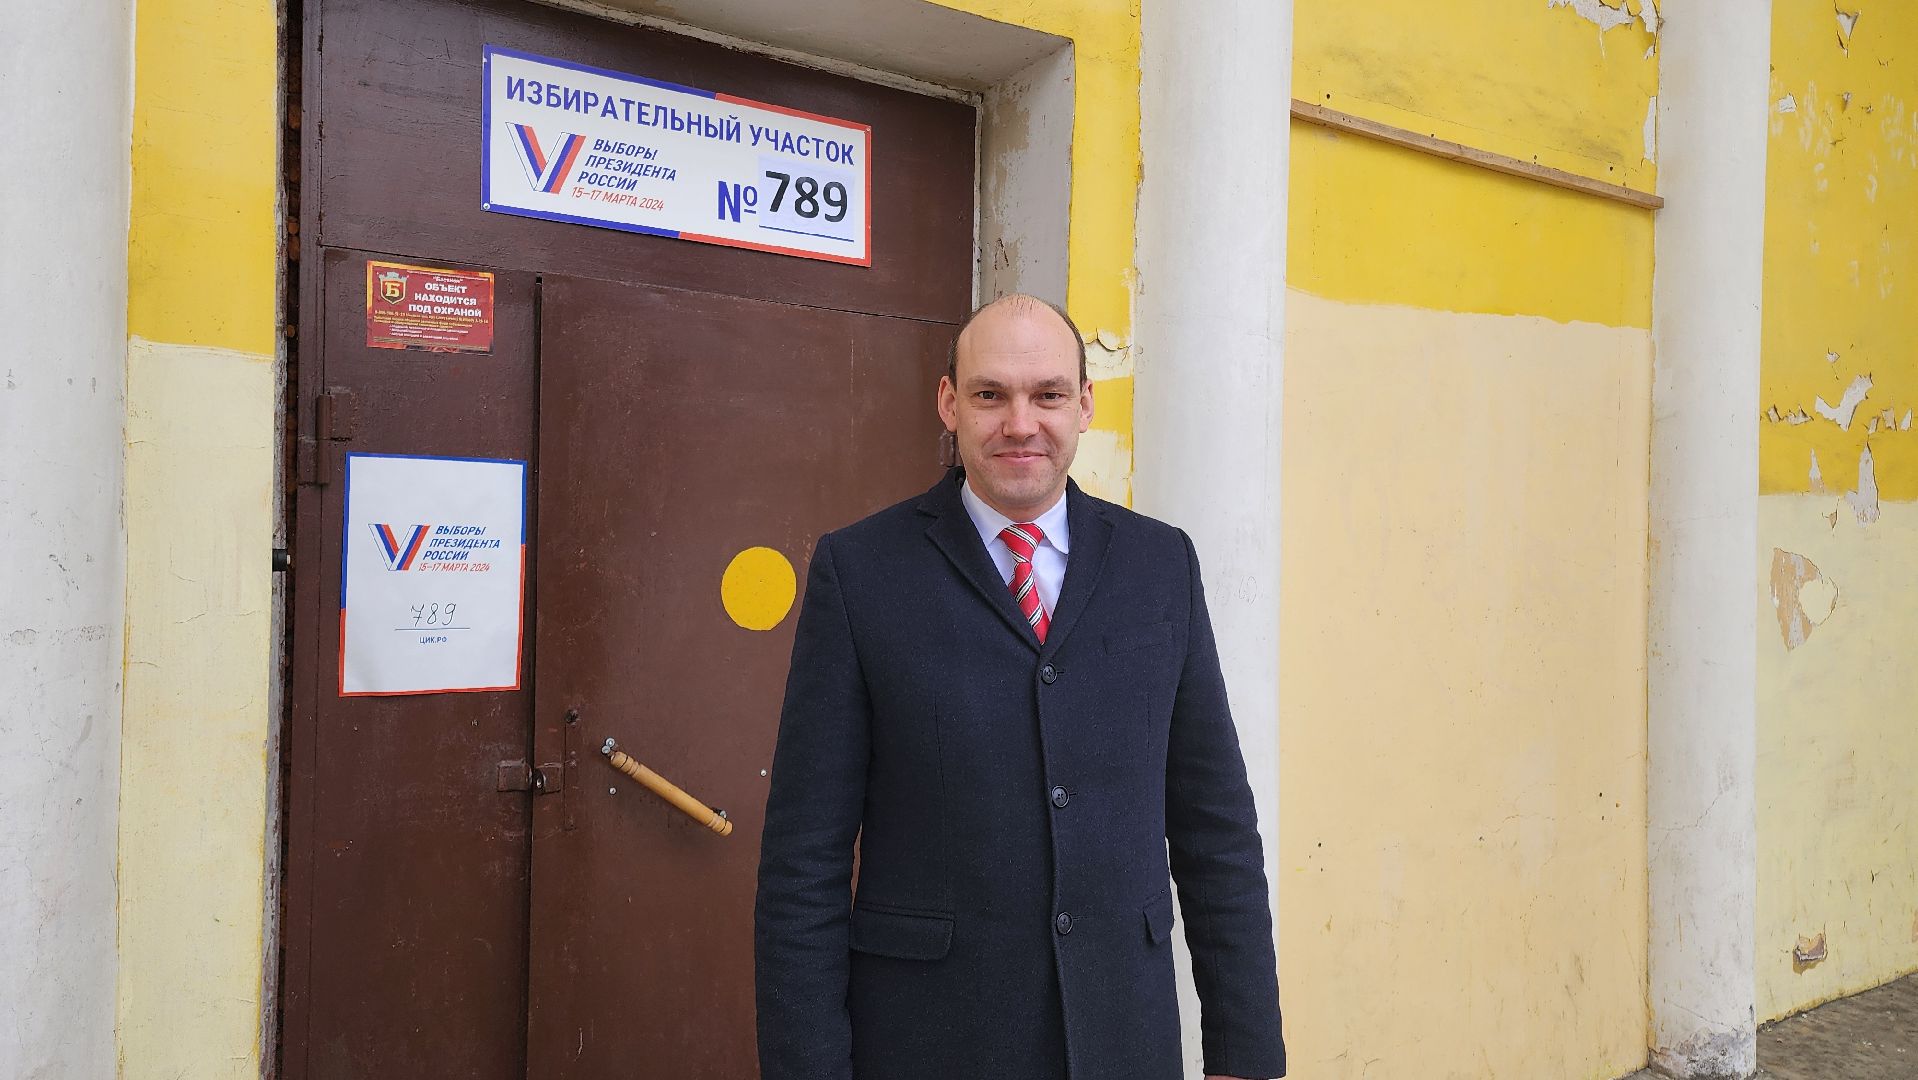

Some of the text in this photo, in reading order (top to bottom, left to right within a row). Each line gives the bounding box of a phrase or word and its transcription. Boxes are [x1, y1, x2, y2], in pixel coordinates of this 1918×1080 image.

[506, 75, 855, 166] ИЗБИРАТЕЛЬНЫЙ УЧАСТОК
[593, 138, 658, 161] ВЫБОРЫ
[585, 154, 677, 182] ПРЕЗИДЕНТА
[577, 170, 639, 192] РОССИИ
[602, 191, 638, 207] МАРТА
[639, 197, 665, 212] 2024
[718, 170, 848, 223] № 789
[424, 282, 468, 294] ОБЪЕКТ
[414, 292, 477, 306] НАХОДИТСЯ
[408, 303, 432, 315] ПОД
[433, 305, 482, 318] ОХРАНОЙ
[435, 525, 487, 536] ВЫБОРЫ
[429, 538, 501, 549] ПРЕЗИДЕНТА
[423, 550, 470, 561] РОССИИ
[441, 563, 469, 572] МАРТА
[469, 563, 491, 572] 2024
[410, 602, 457, 627] 789
[419, 636, 448, 645] ЦИК.РФ
